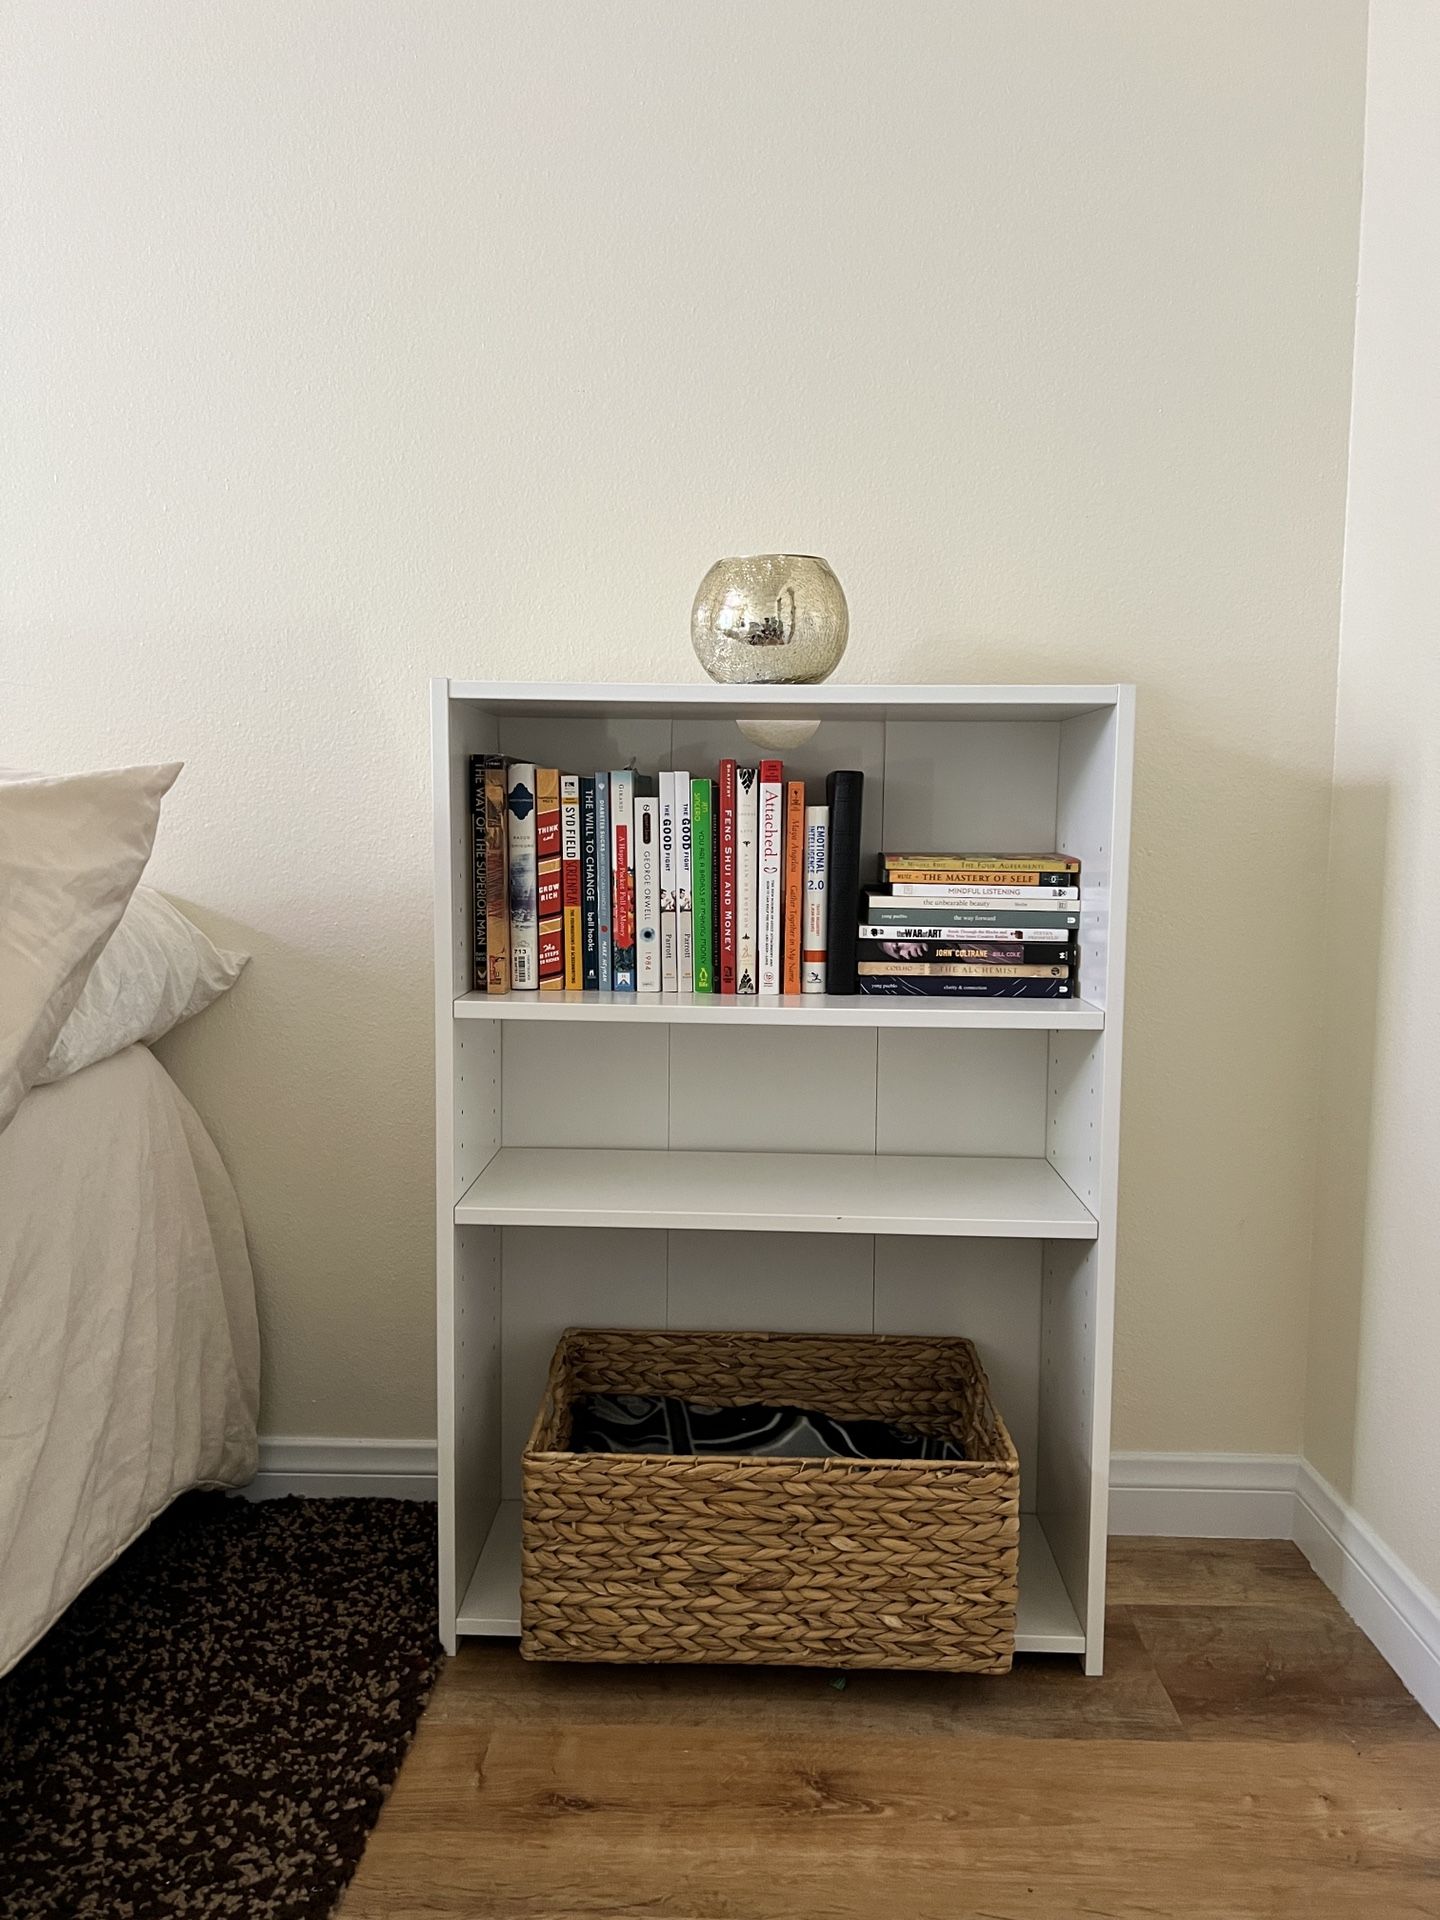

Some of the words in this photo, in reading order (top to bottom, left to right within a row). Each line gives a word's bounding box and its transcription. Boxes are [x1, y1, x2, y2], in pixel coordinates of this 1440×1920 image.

[475, 764, 485, 784] THE
[475, 787, 486, 814] WAY
[585, 789, 594, 809] THE
[475, 817, 486, 833] OF
[565, 807, 576, 827] SYD
[585, 812, 594, 836] WILL
[764, 789, 779, 862] Attached.
[538, 824, 559, 835] THINK
[663, 819, 672, 851] GOOD
[681, 818, 690, 850] GOOD
[789, 818, 800, 841] Maya
[476, 838, 486, 858] THE
[566, 830, 577, 858] FIELD
[585, 840, 595, 853] TO
[618, 843, 626, 865] Happy
[816, 825, 826, 874] EMOTIONAL
[643, 850, 651, 885] GEORGE
[789, 843, 799, 873] Angelou
[999, 862, 1045, 870] AGREEMENTS
[538, 883, 560, 894] GROW
[566, 860, 578, 907] SCREENPLAY
[586, 856, 595, 902] CHANGE
[807, 879, 825, 891] 2.0
[922, 873, 942, 881] THE
[946, 874, 990, 882] MASTERY
[1010, 875, 1033, 883] SELF
[476, 861, 487, 917] SUPERIOR
[540, 892, 559, 902] RICH
[789, 885, 798, 908] Gather
[948, 887, 980, 895] MINDFUL
[982, 887, 1021, 895] LISTENING
[644, 888, 652, 920] ORWELL
[934, 899, 968, 907] unbearable
[587, 911, 595, 927] bell
[788, 909, 798, 937] Together
[477, 920, 487, 946] MAN
[587, 928, 595, 952] hooks
[789, 938, 795, 946] in
[787, 948, 796, 960] My
[935, 949, 952, 957] JOHN
[954, 949, 988, 958] COLTRANE
[787, 962, 795, 983] Name
[963, 966, 1018, 974] ALCHEMIST
